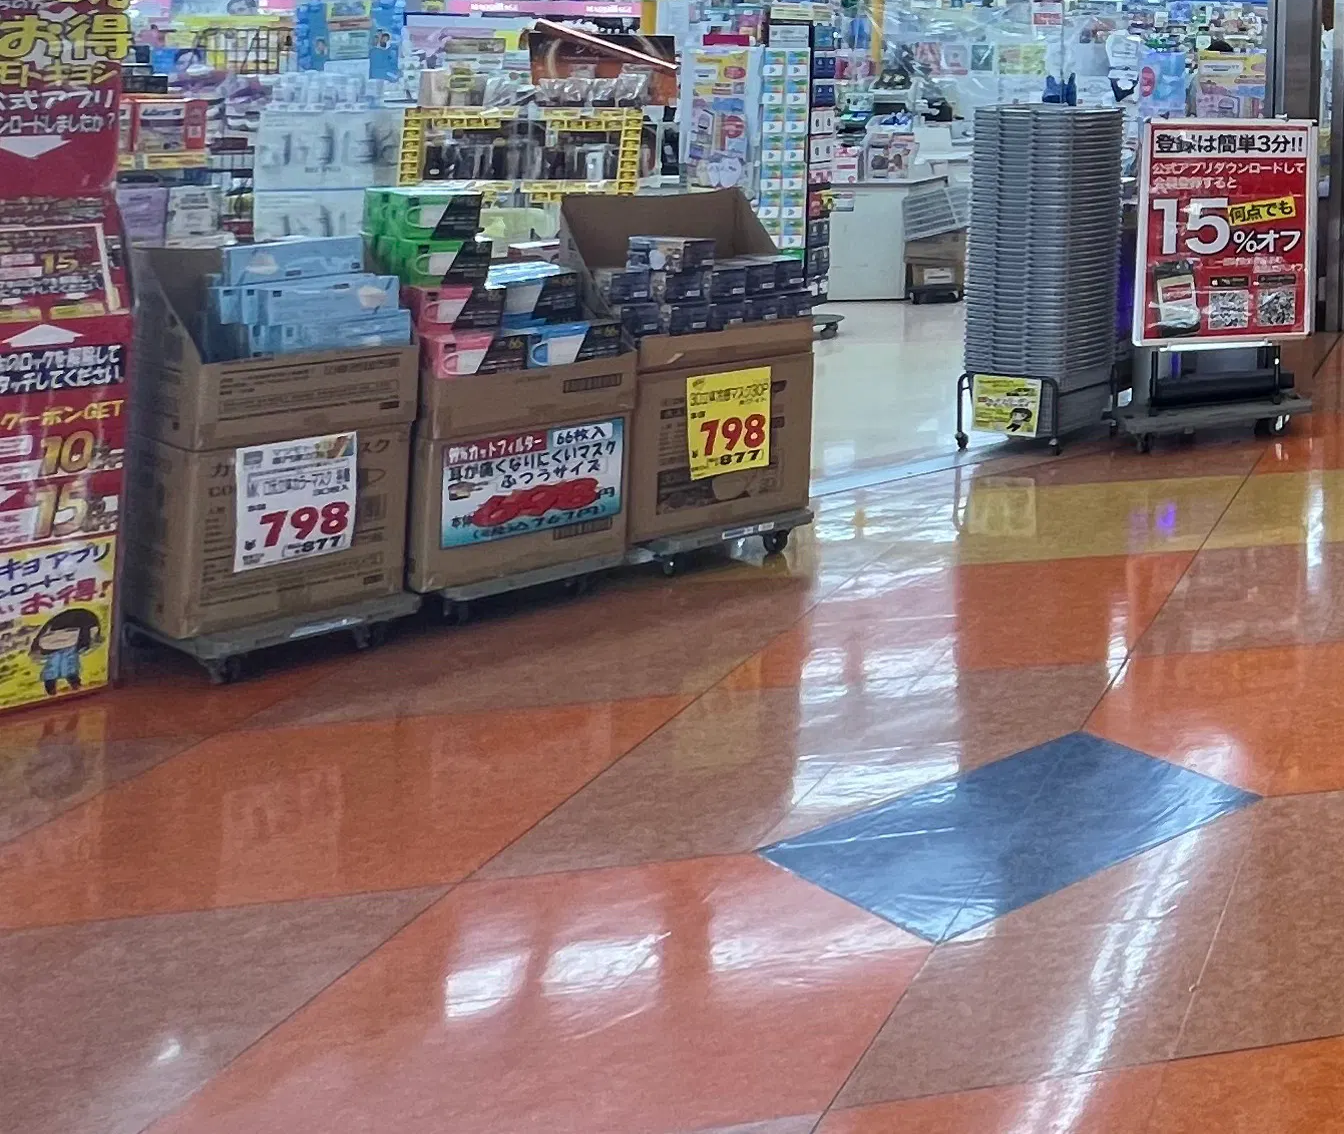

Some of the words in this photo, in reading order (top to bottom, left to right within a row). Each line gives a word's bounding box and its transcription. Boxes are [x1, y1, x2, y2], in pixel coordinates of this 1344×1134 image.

[1152, 162, 1306, 176] 公式アプリダウンロードして
[1152, 197, 1231, 255] 15
[1229, 200, 1294, 224] 何点でも
[40, 252, 79, 274] 15
[557, 426, 605, 445] 66枚入
[700, 413, 767, 457] 798
[38, 430, 94, 477] 10
[449, 441, 616, 482] 耳が痛くなりにくいマスク
[719, 448, 761, 466] 877
[500, 459, 601, 489] ふつうサイズ
[33, 480, 88, 540] 15
[259, 501, 350, 548] 798
[300, 535, 342, 553] 877
